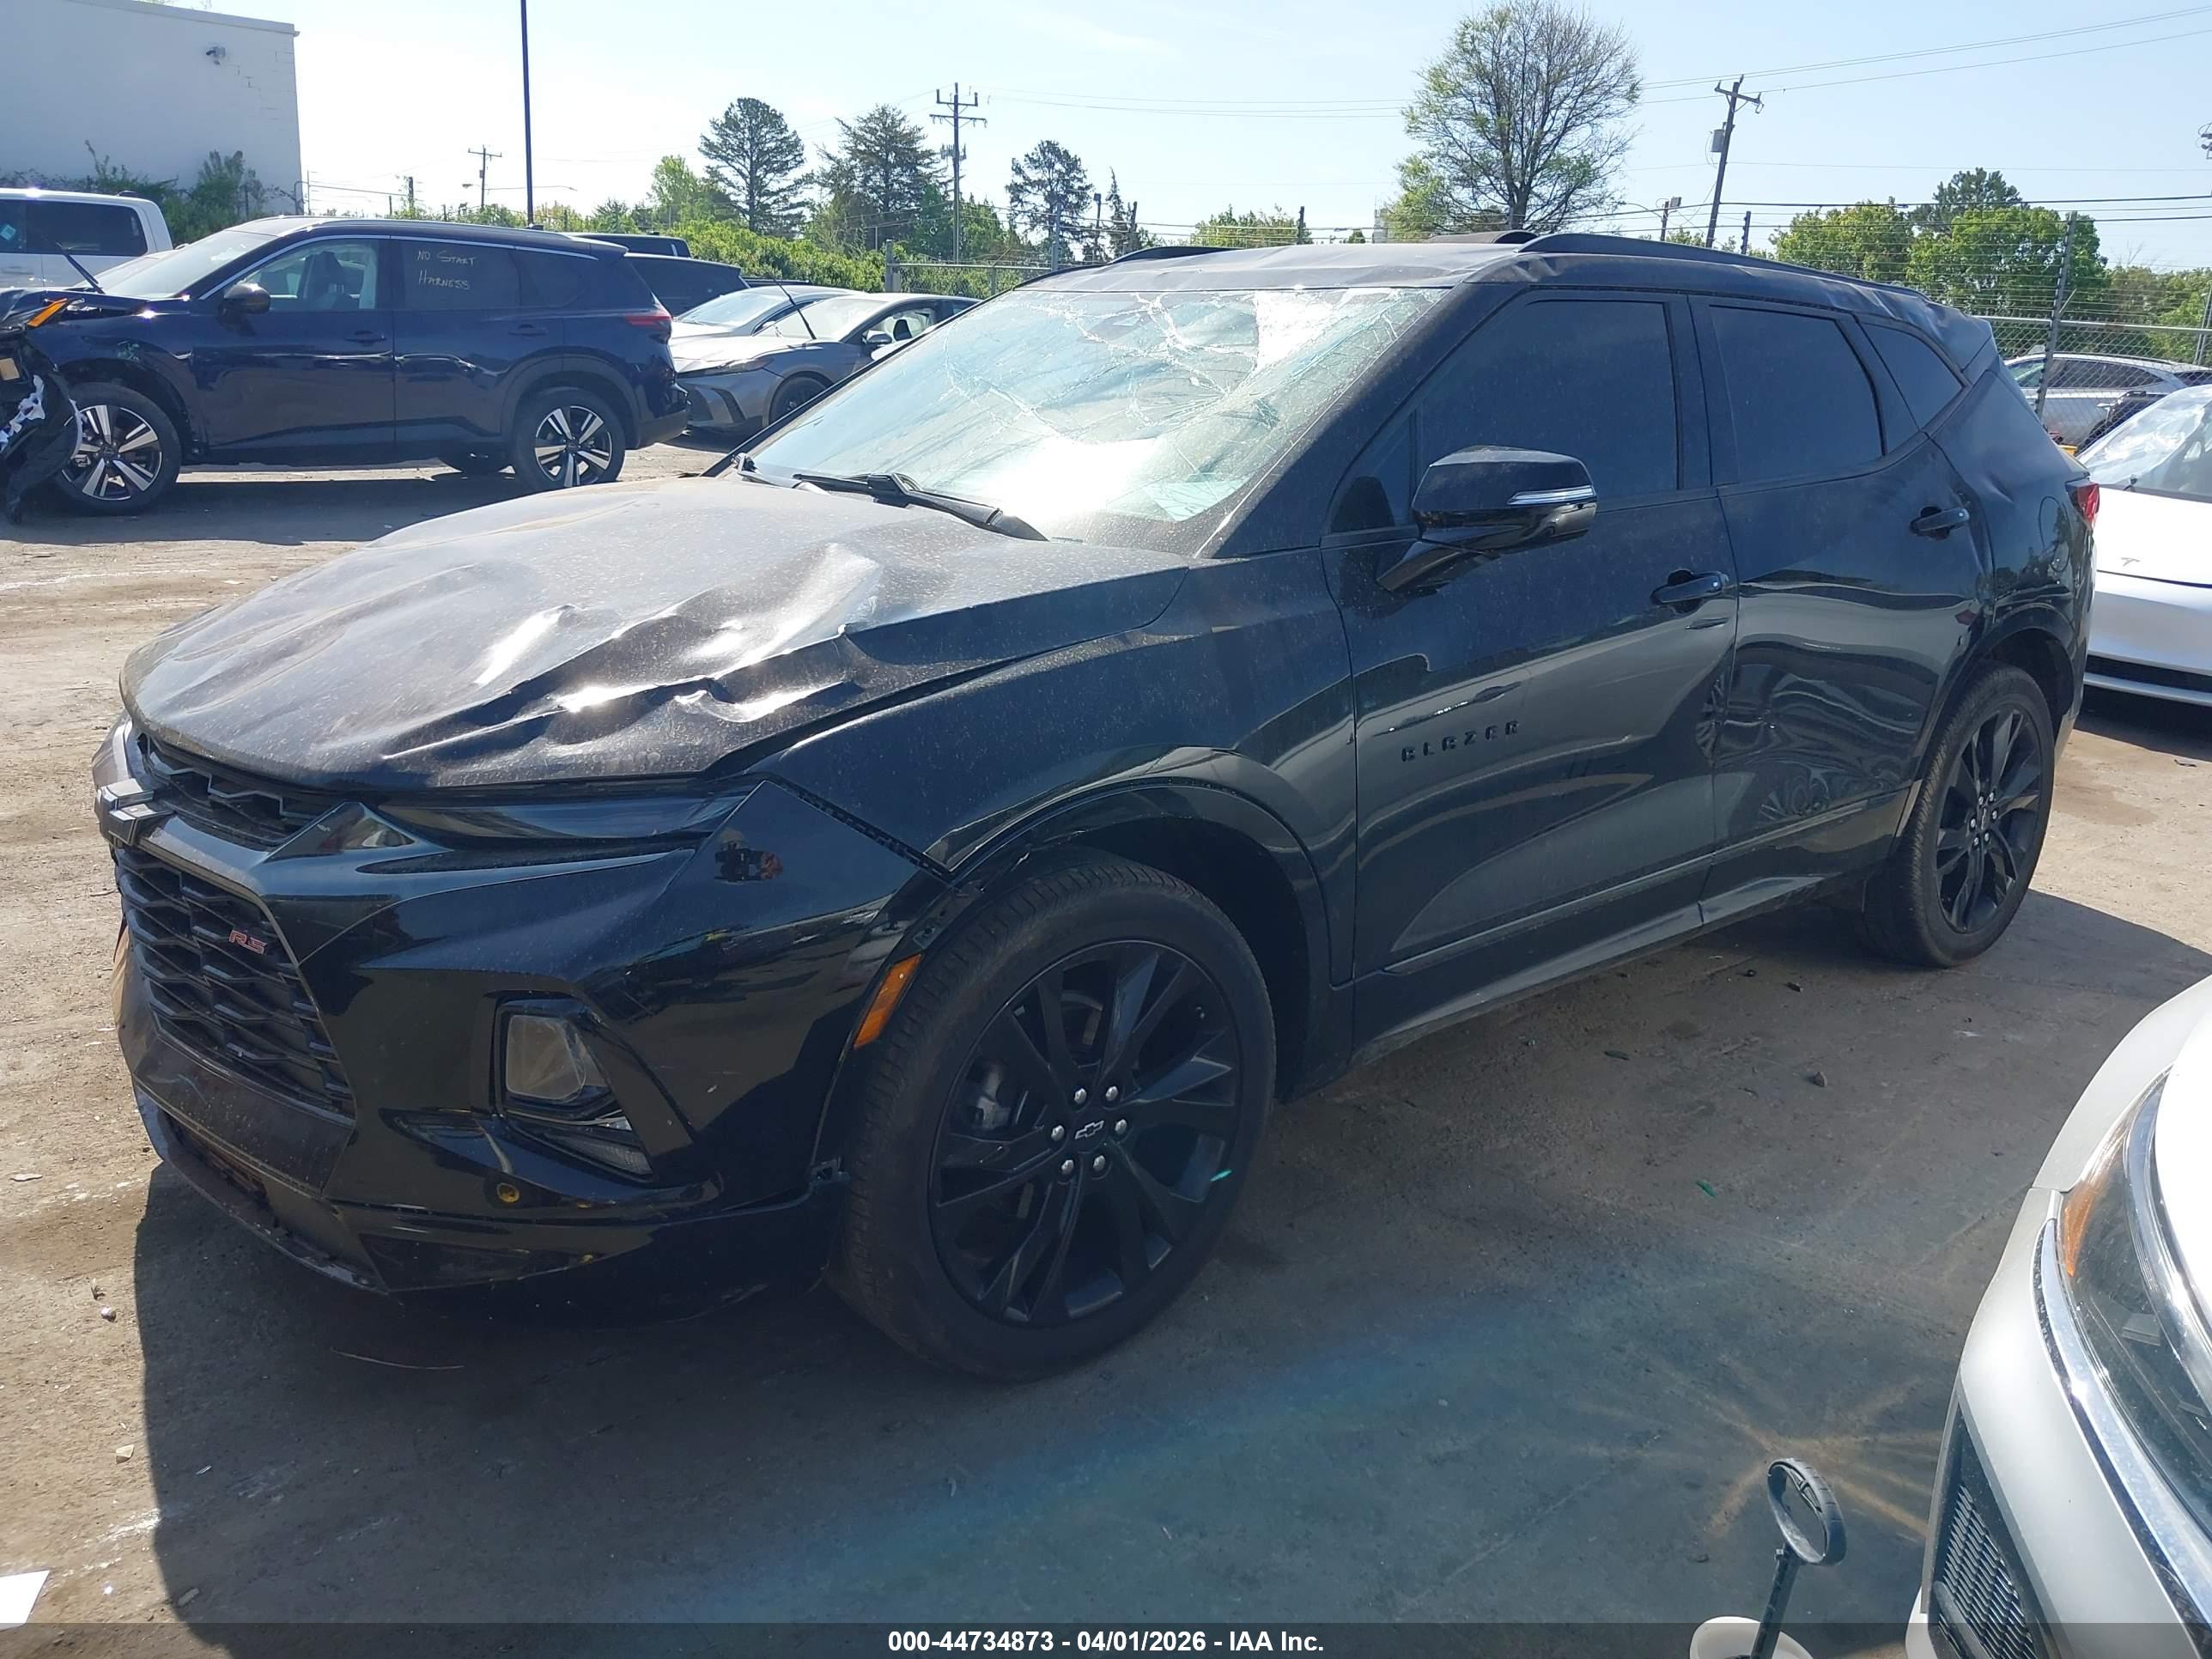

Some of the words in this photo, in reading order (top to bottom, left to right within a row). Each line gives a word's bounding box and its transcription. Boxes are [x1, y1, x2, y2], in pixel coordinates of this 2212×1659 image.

[417, 250, 431, 261] NO
[437, 250, 477, 266] START
[418, 269, 471, 290] HARNESS
[1401, 720, 1519, 763] BLAZER
[228, 928, 267, 955] RS
